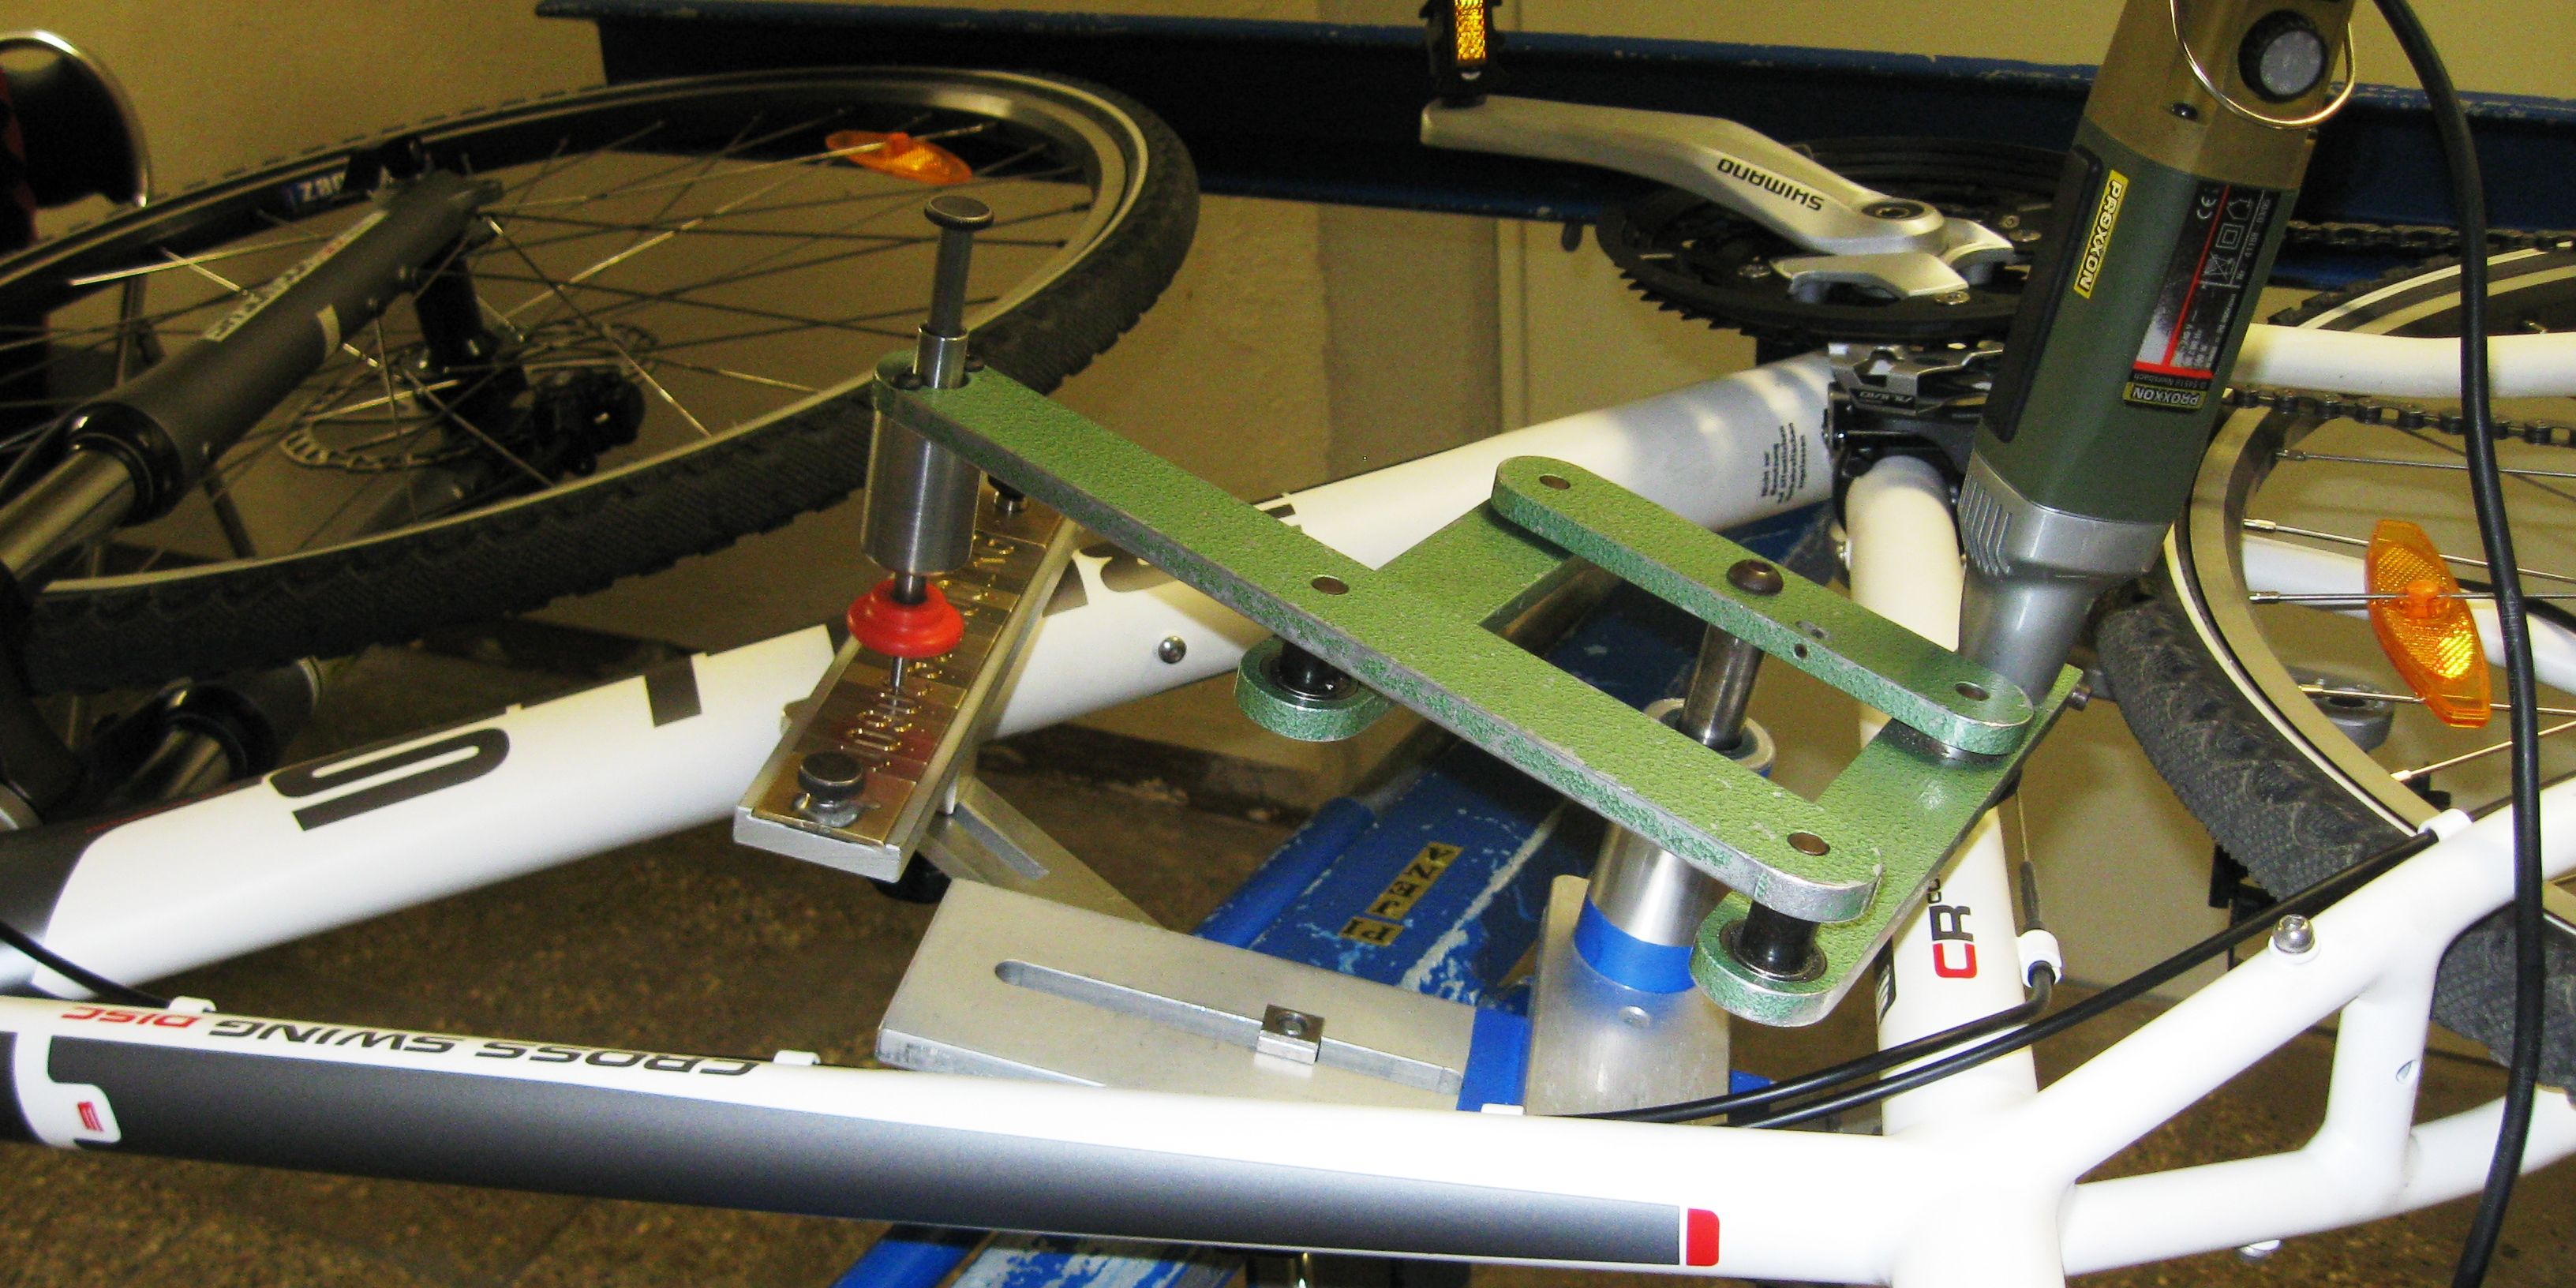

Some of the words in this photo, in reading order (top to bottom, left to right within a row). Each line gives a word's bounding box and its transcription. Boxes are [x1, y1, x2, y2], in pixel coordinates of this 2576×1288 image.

[1717, 158, 1825, 211] SHIMANO
[2079, 180, 2123, 292] PROXXON
[2132, 387, 2200, 406] PROXXON
[61, 1005, 201, 1028] DISC
[209, 1019, 467, 1053] SWING
[475, 1040, 759, 1076] CROSS
